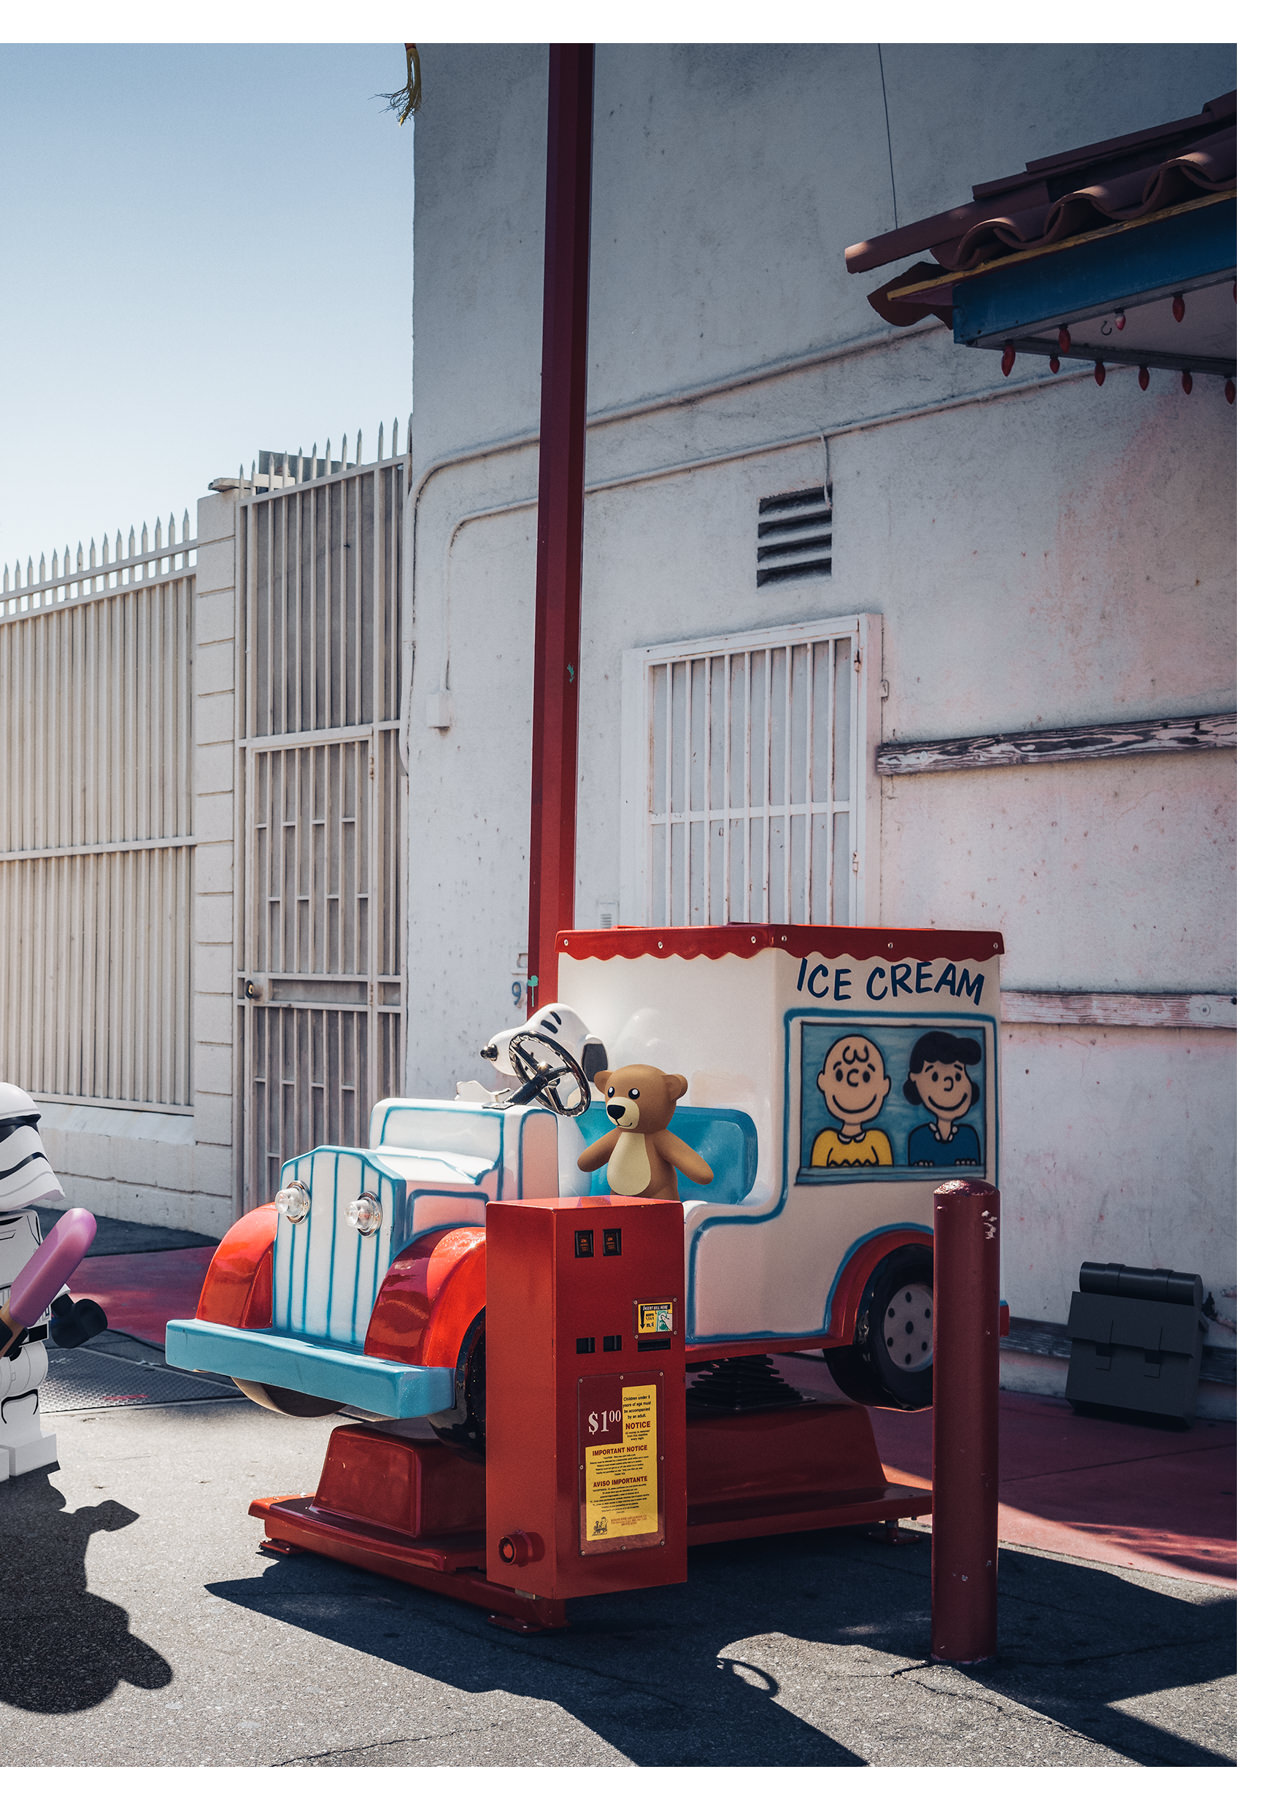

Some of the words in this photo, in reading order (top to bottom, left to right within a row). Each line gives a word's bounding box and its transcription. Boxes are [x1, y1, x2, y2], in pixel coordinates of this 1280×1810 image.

[797, 957, 852, 1001] ICE
[866, 961, 985, 1006] CREAM
[625, 1421, 651, 1430] NOTICE
[592, 1446, 625, 1456] IMPORTANT
[626, 1445, 648, 1453] NOTICE
[593, 1479, 610, 1488] AVISO
[611, 1475, 648, 1486] IMPORTANTE
